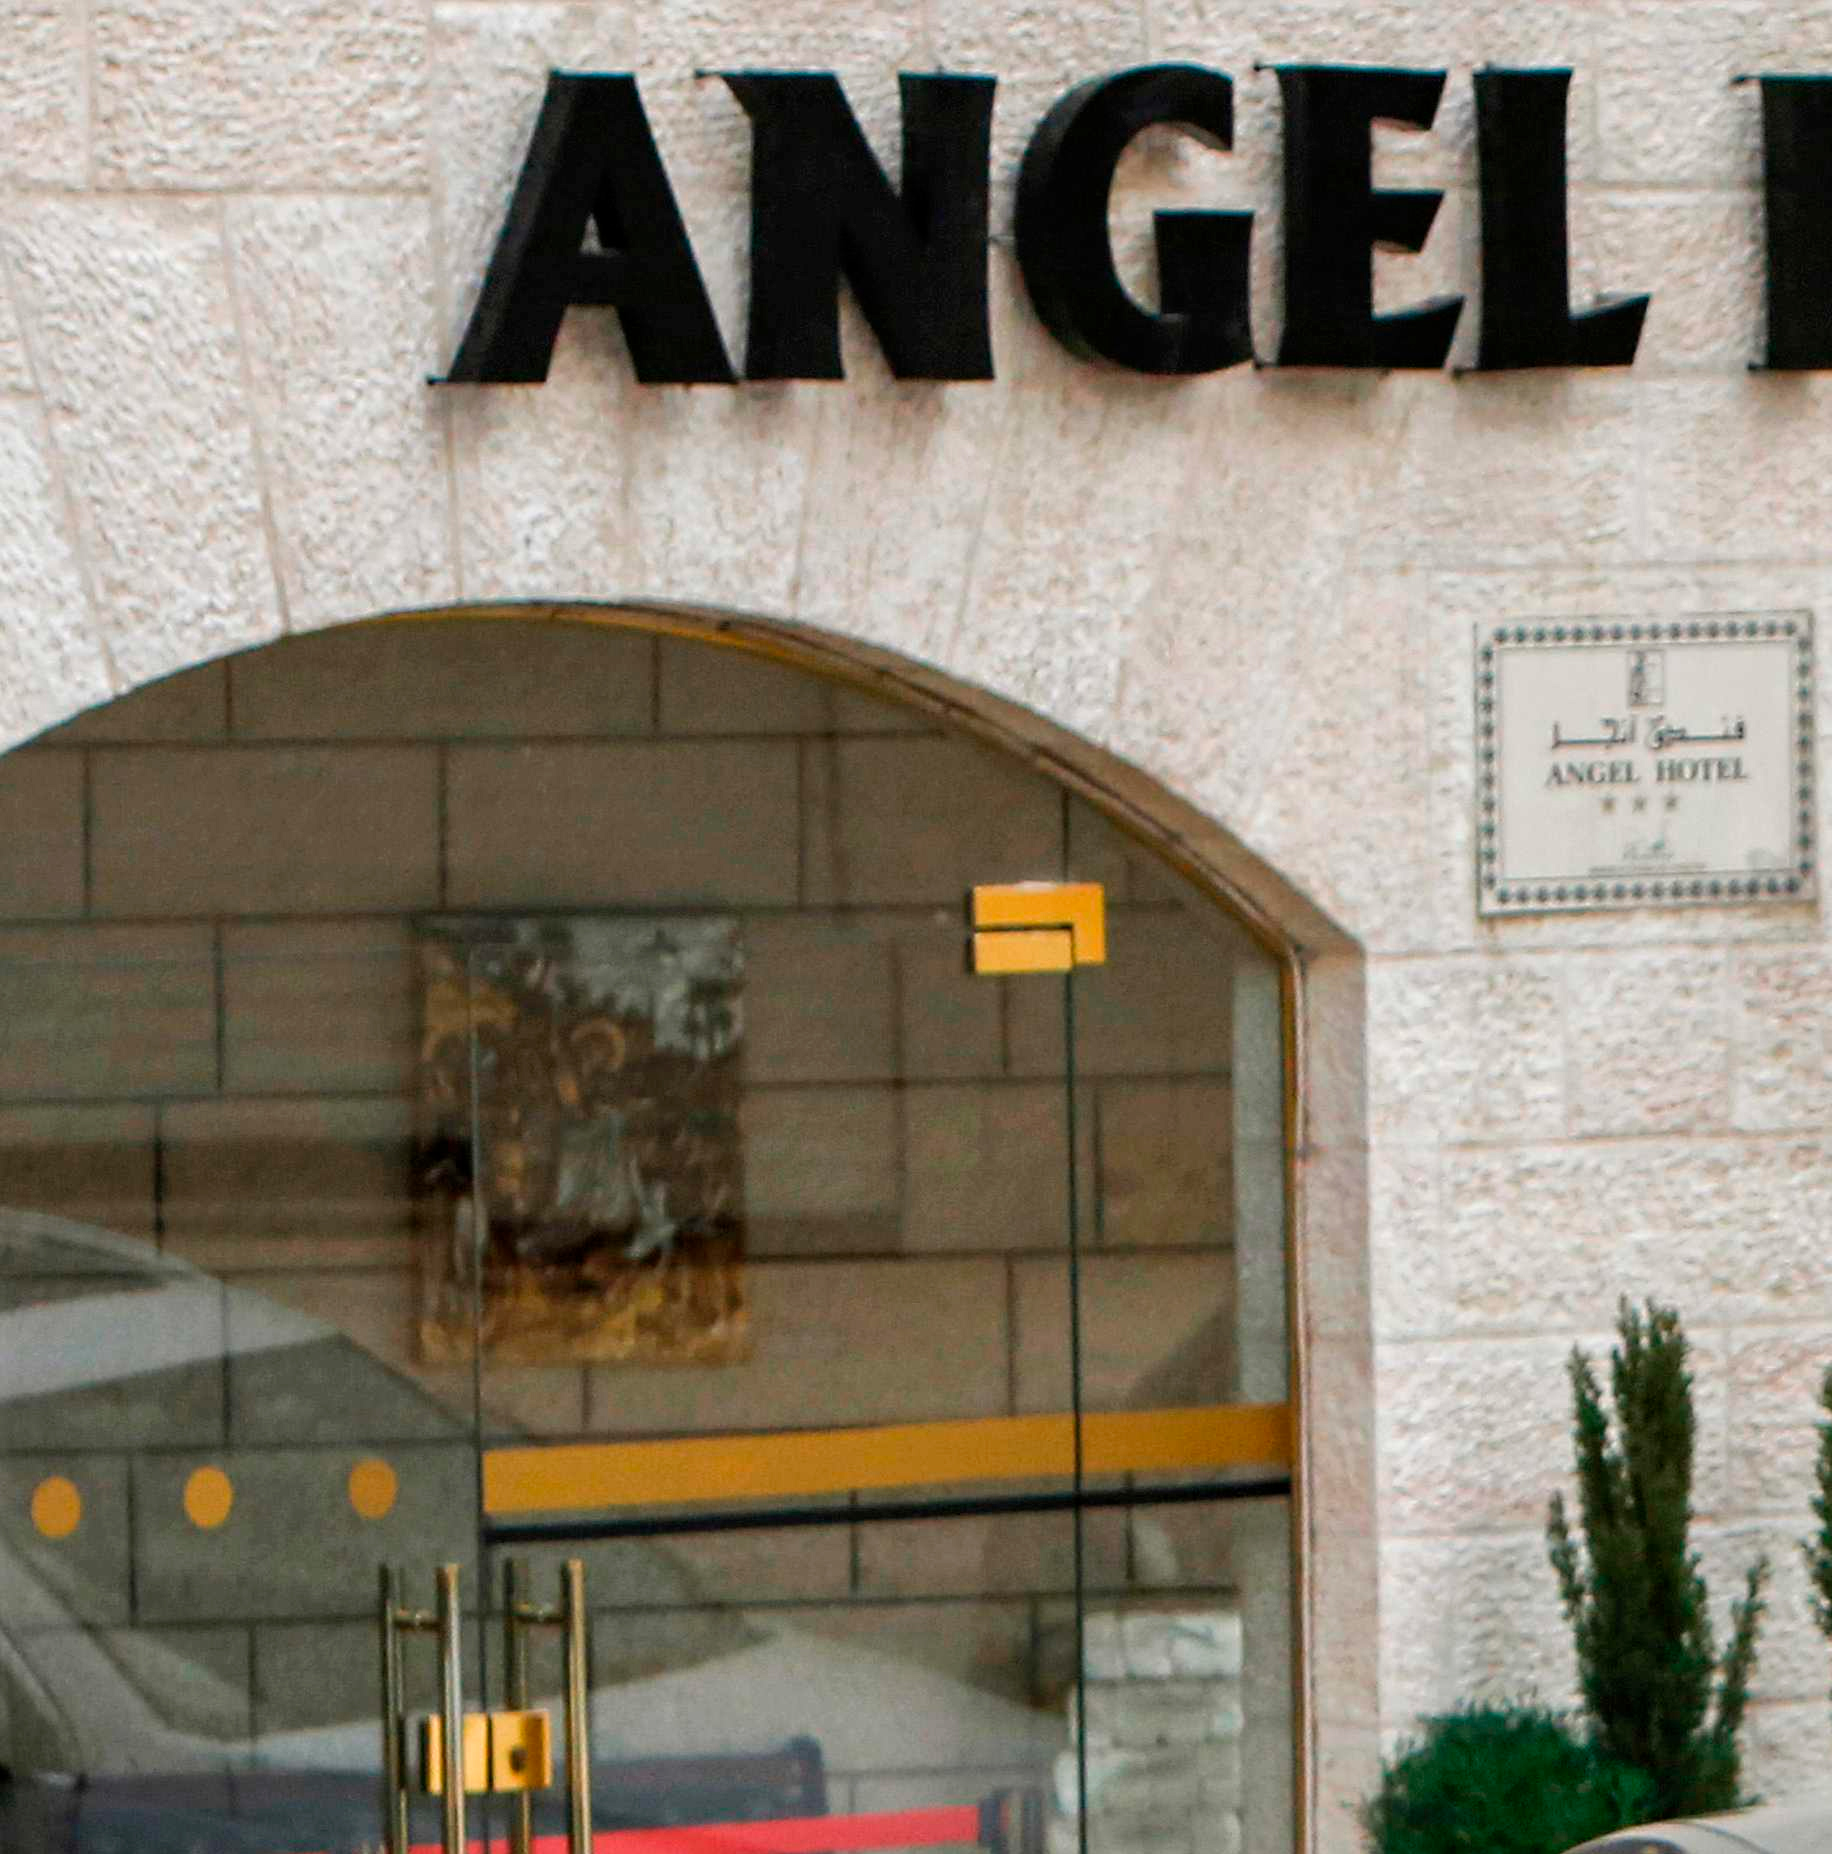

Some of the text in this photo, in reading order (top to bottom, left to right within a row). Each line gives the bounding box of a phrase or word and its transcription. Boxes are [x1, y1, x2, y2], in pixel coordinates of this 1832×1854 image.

[427, 62, 1651, 385] ANGEL
[1546, 756, 1749, 786] ANGEL HOTEL
